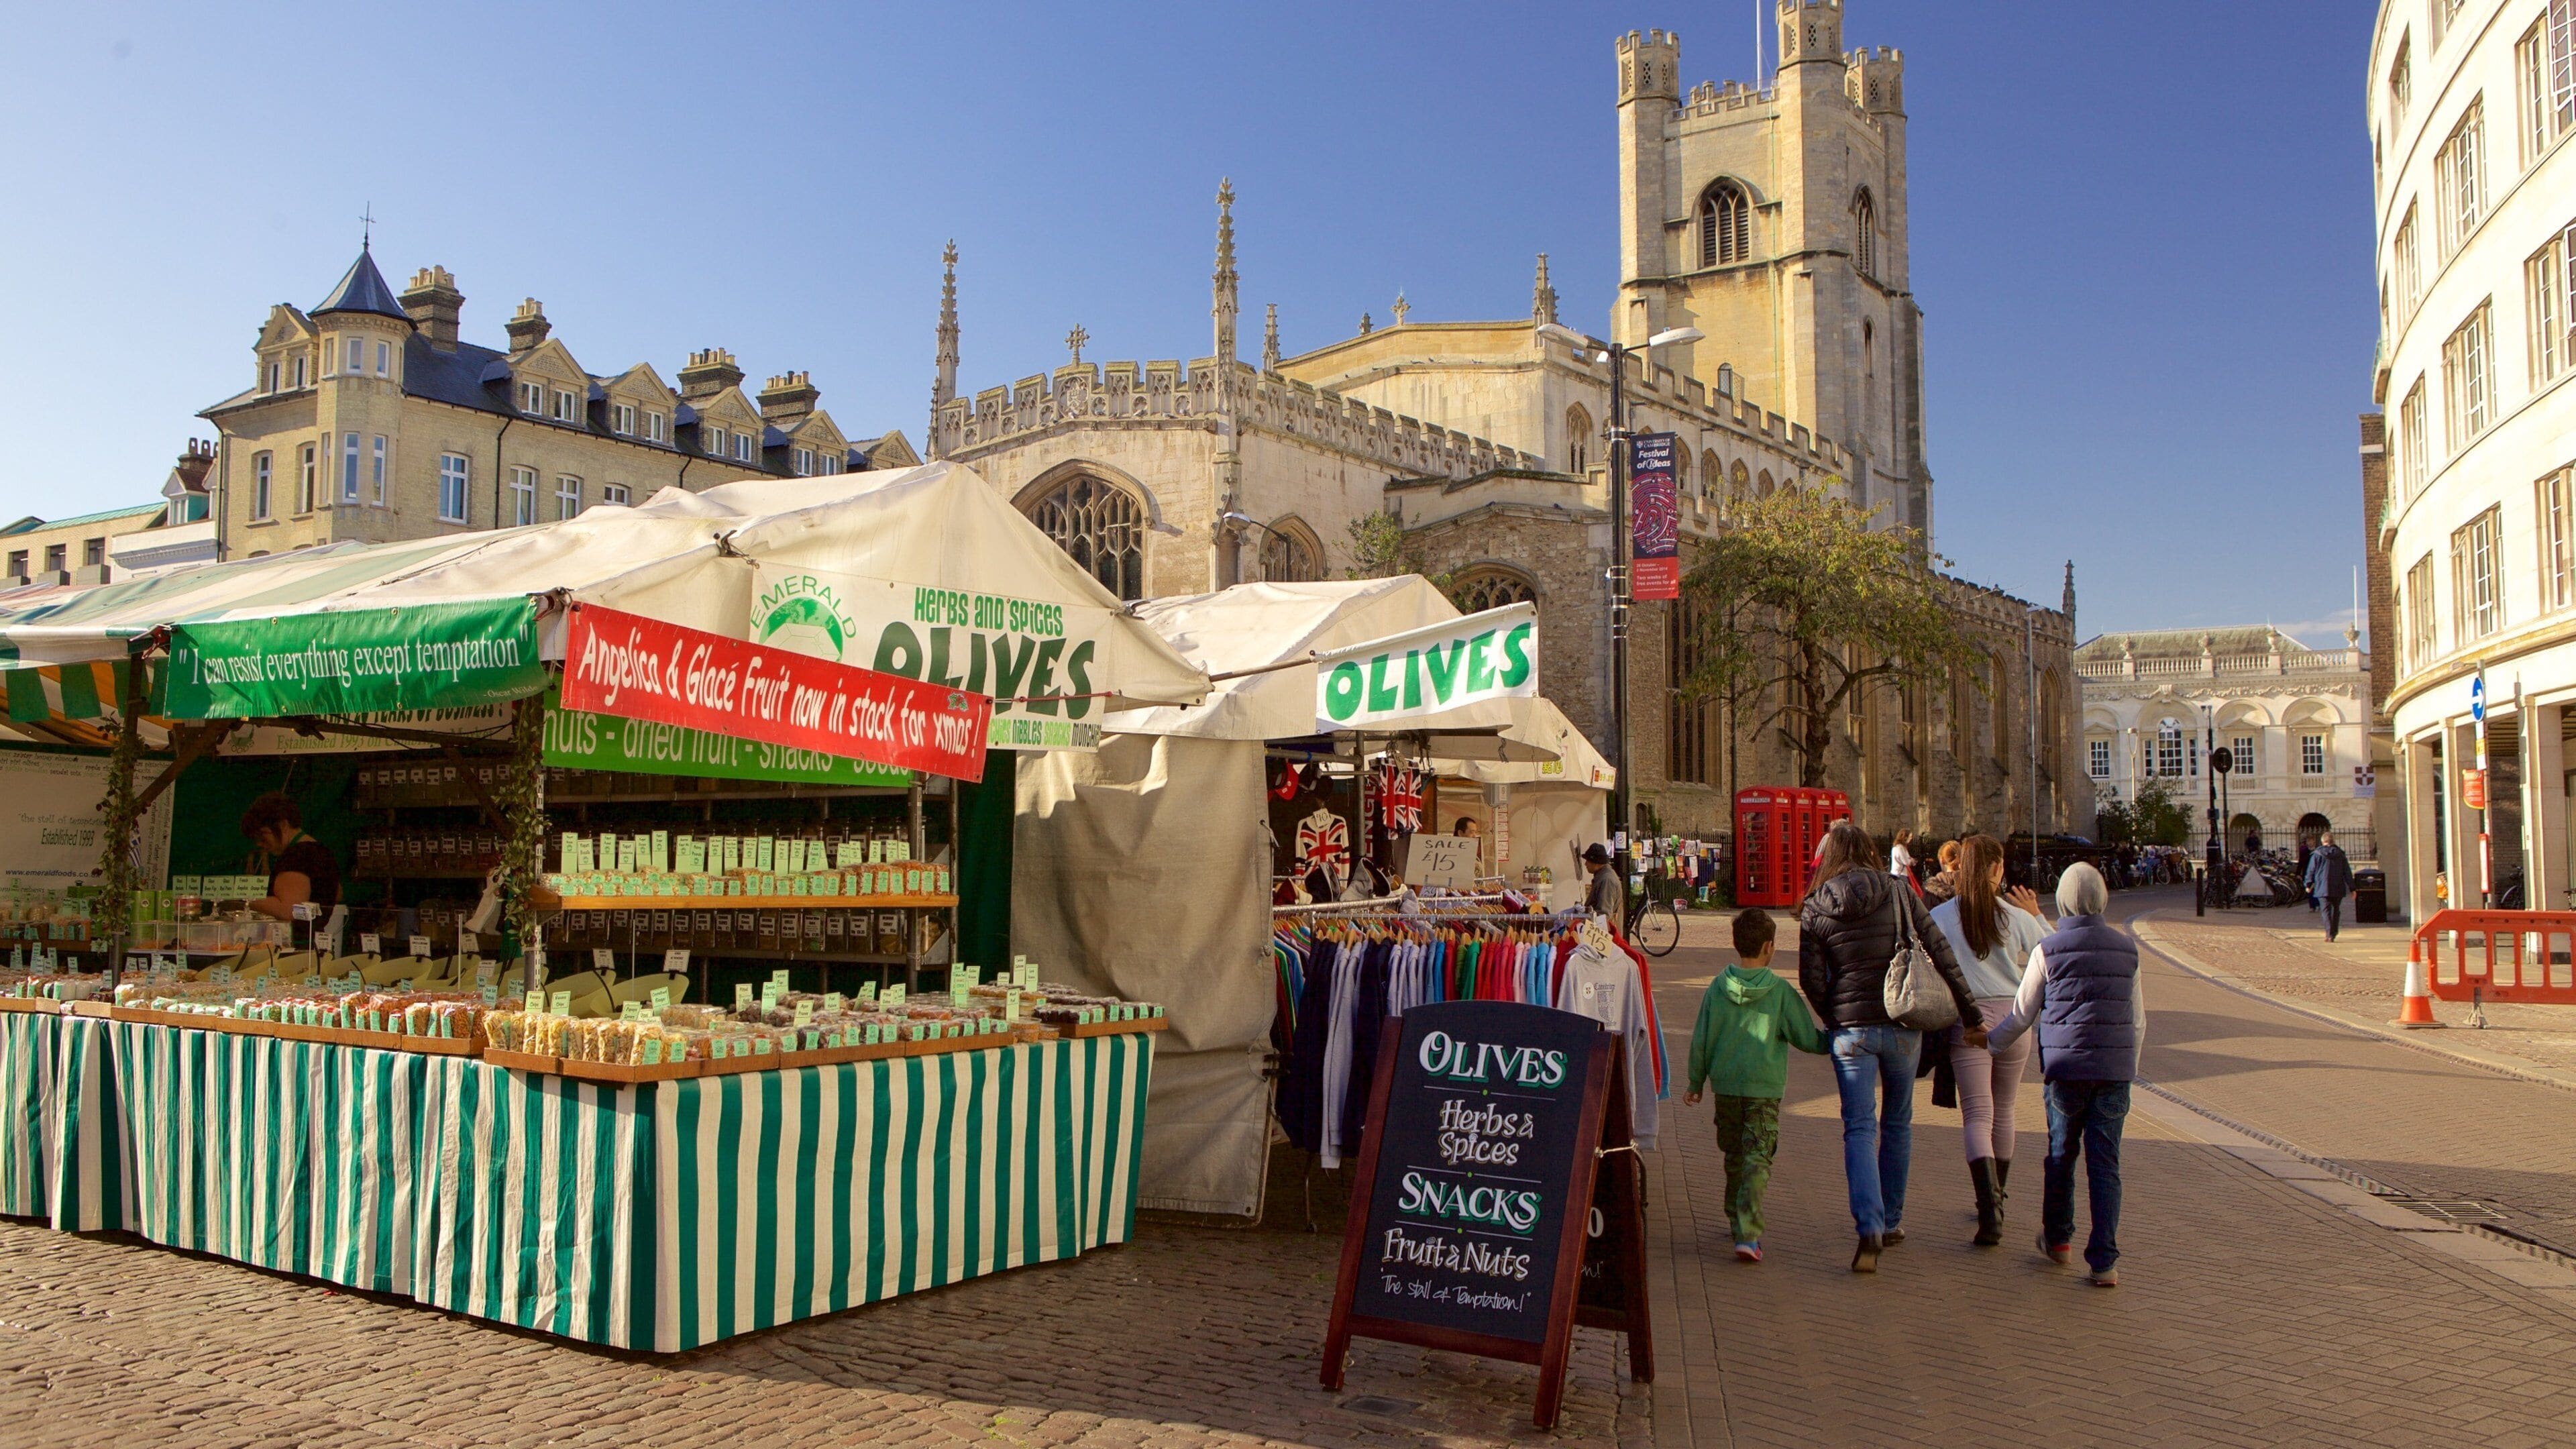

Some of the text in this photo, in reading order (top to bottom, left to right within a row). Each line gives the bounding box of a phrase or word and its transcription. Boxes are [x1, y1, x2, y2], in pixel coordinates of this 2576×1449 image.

[1637, 460, 1671, 469] of Ideas
[1638, 448, 1669, 459] Festival
[750, 575, 857, 639] EMERALD
[204, 657, 229, 684] can
[228, 643, 264, 683] resist
[266, 637, 352, 690] everything
[354, 637, 412, 686] except
[872, 621, 1095, 719] OLIVES
[1326, 622, 1532, 722] OLIVES
[513, 686, 538, 695] Wilde
[577, 621, 983, 760] Angelica & Glacé Fruit now in stock for xmas!
[277, 734, 331, 751] Established
[339, 735, 364, 750] 1993
[368, 737, 382, 748] on
[542, 710, 597, 755] nuts
[623, 719, 684, 761] dried
[41, 828, 95, 847] Established 1993
[1425, 839, 1470, 850] SALE
[1421, 850, 1458, 872] £15
[1586, 930, 1607, 952] £15
[1589, 923, 1610, 941] SALE
[1419, 1030, 1568, 1088] OLIVES
[1438, 1099, 1518, 1138] Herbs
[1440, 1131, 1519, 1166] Spices
[1398, 1171, 1542, 1234] SNACKS
[1381, 1228, 1446, 1267] Fruit
[1460, 1241, 1531, 1281] Nuts
[1407, 1279, 1432, 1299] stall
[1432, 1289, 1451, 1303] of
